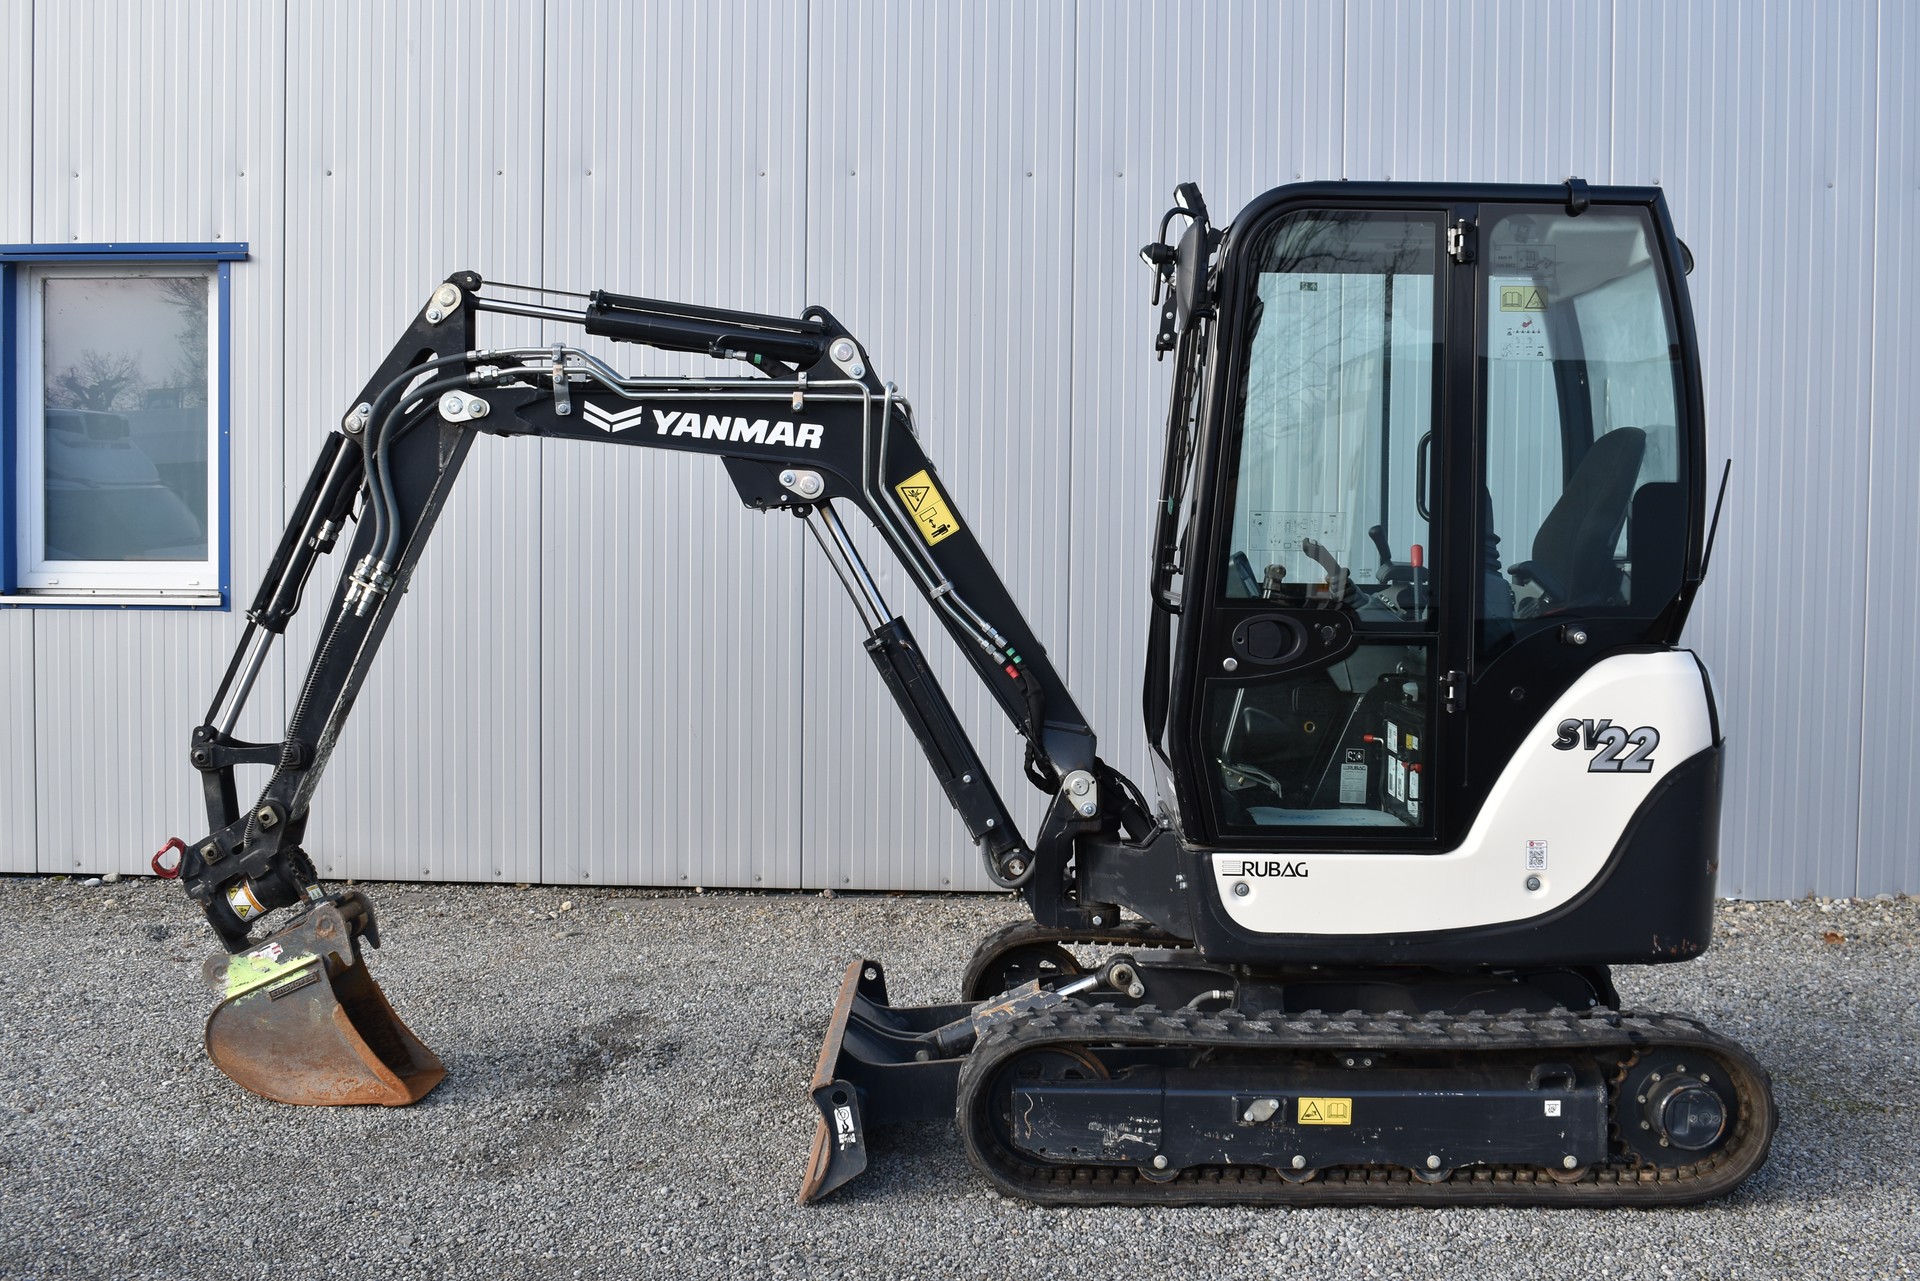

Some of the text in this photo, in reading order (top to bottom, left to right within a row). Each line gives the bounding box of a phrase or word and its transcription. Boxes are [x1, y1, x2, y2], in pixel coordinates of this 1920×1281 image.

[652, 409, 825, 449] YANMAR
[1551, 718, 1660, 773] SV22
[1240, 861, 1308, 877] RUBAG
